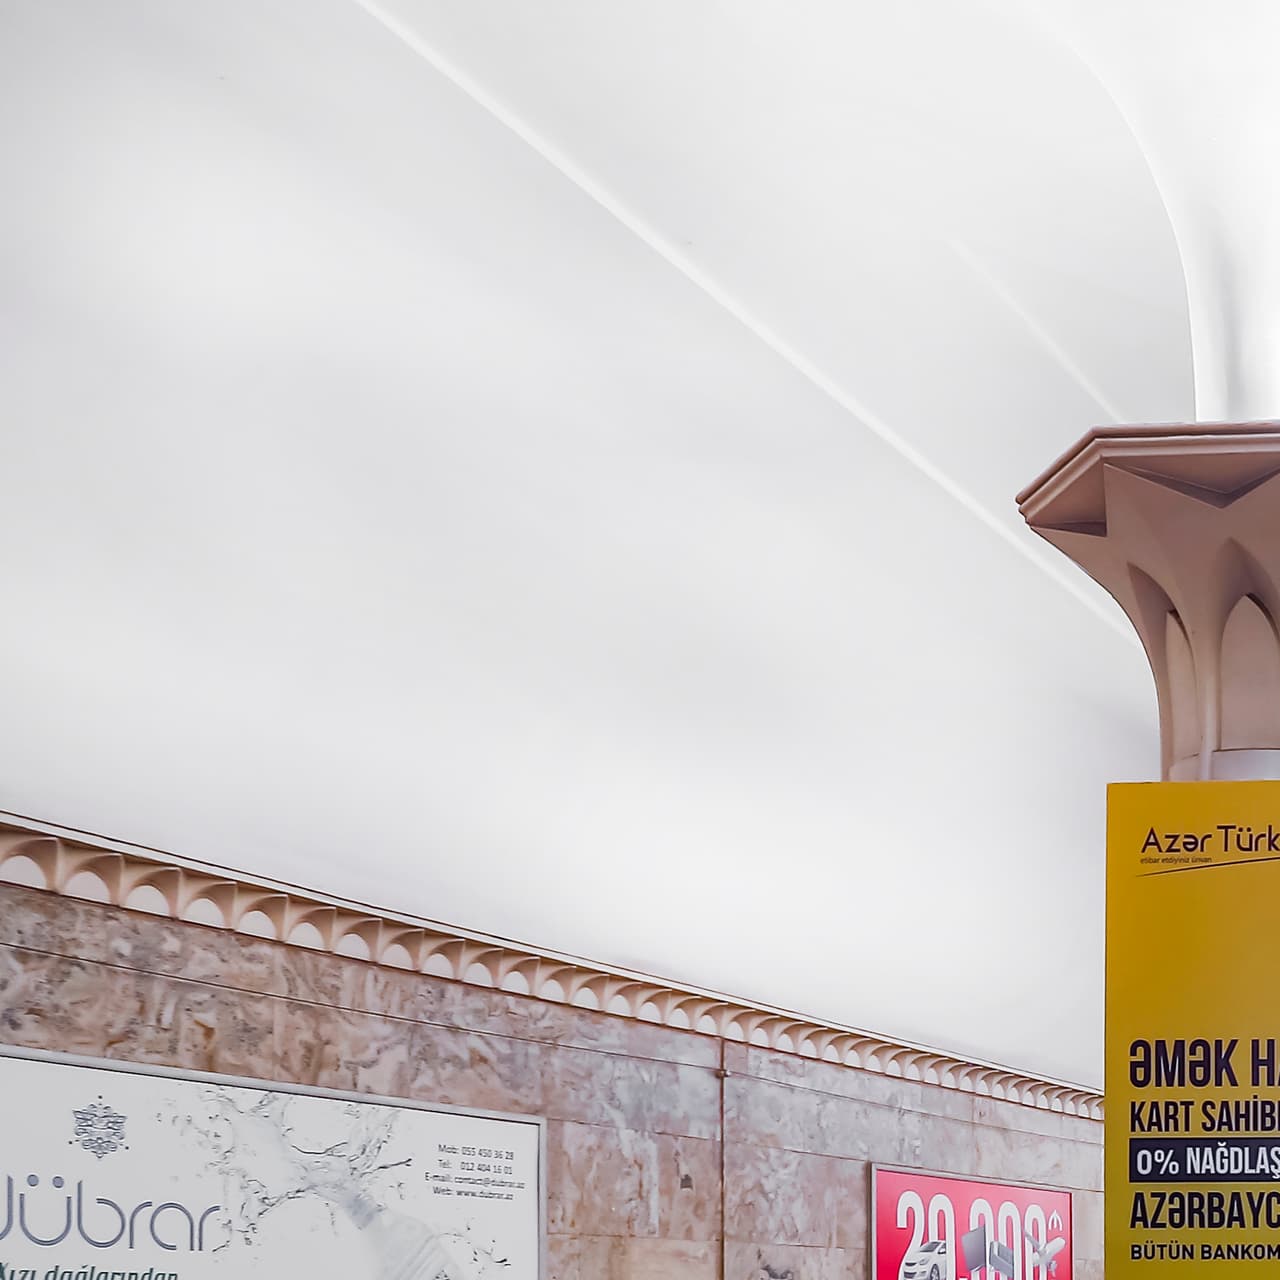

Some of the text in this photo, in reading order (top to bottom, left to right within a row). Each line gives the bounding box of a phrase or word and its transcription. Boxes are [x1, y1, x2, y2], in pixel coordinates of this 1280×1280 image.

[1141, 827, 1212, 853] Azər
[1216, 825, 1280, 852] Türk
[1129, 1038, 1239, 1088] ƏMƏK
[1129, 1100, 1194, 1133] KART
[1136, 1149, 1180, 1176] 0%
[1130, 1240, 1194, 1260] BÜTÜN
